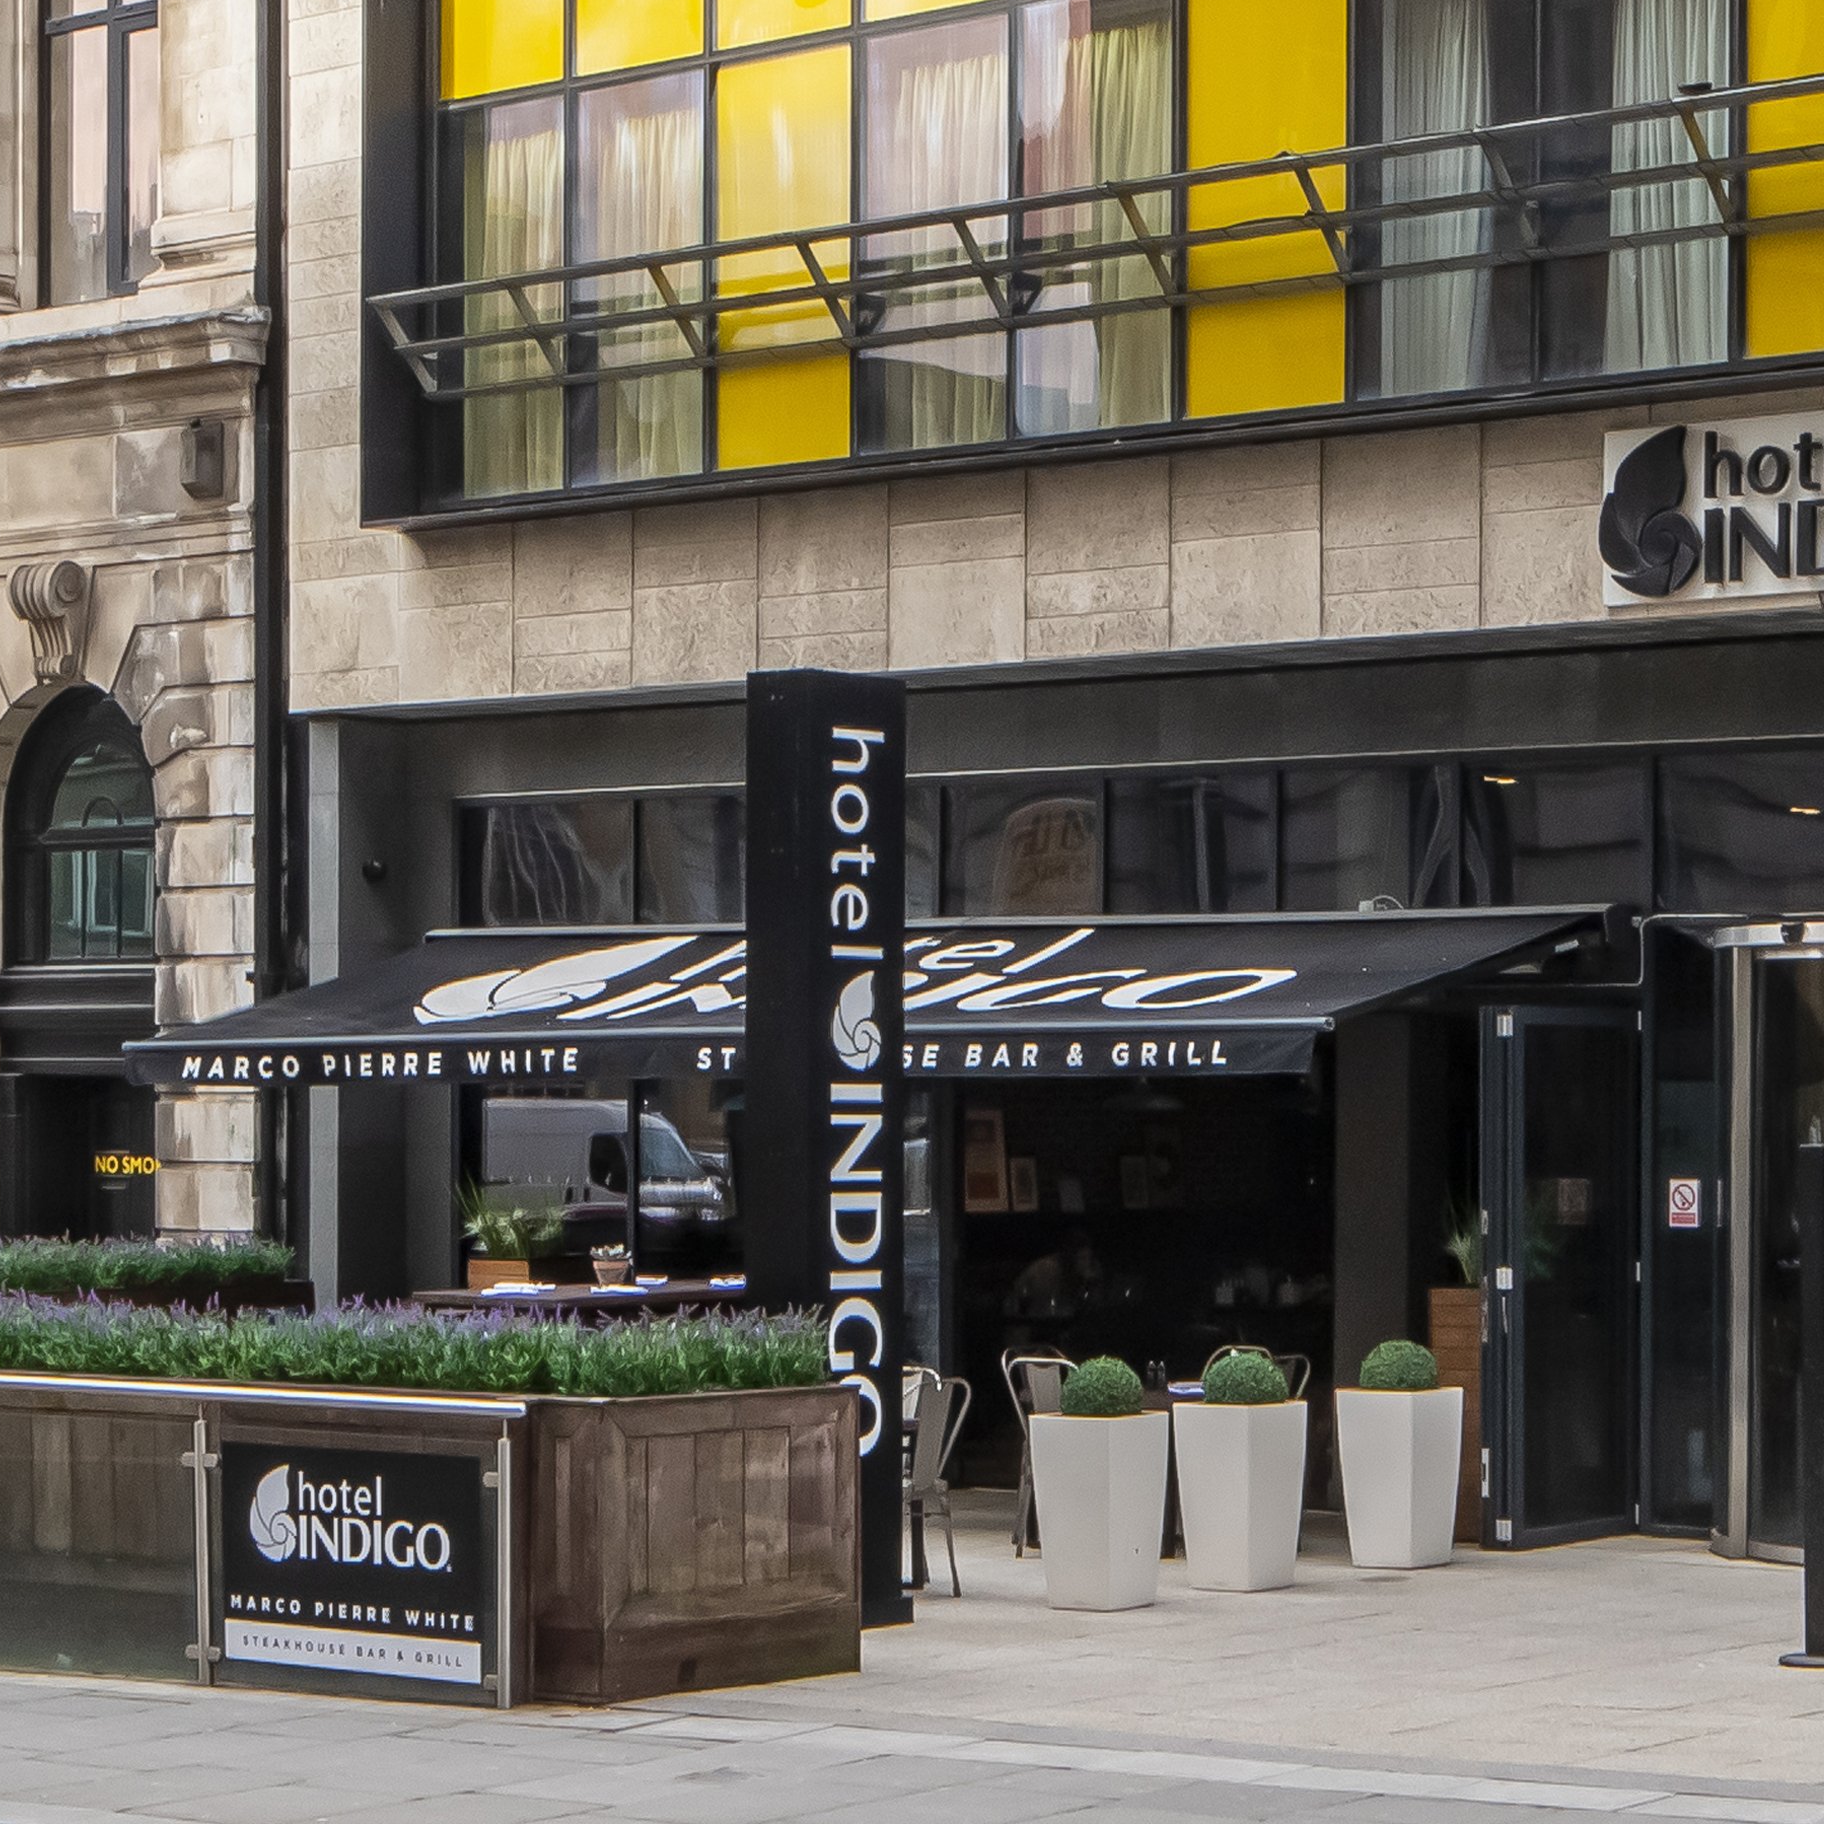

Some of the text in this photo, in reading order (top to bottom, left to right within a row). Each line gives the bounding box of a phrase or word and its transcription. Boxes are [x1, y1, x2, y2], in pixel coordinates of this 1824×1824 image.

[830, 726, 885, 961] hotel
[181, 1047, 578, 1079] MARCO PIERRE WHITE
[964, 1043, 1040, 1068] BAR
[1066, 1042, 1084, 1067] &
[1111, 1040, 1228, 1066] GRILL
[95, 1155, 119, 1174] NO
[297, 1470, 383, 1516] hotel
[298, 1514, 451, 1571] INDIGO
[230, 1594, 475, 1632] MARCO PIERRE WHITE
[242, 1635, 346, 1656] STEAKHOUSE
[356, 1645, 386, 1660] BAR
[414, 1652, 463, 1668] GRILL
